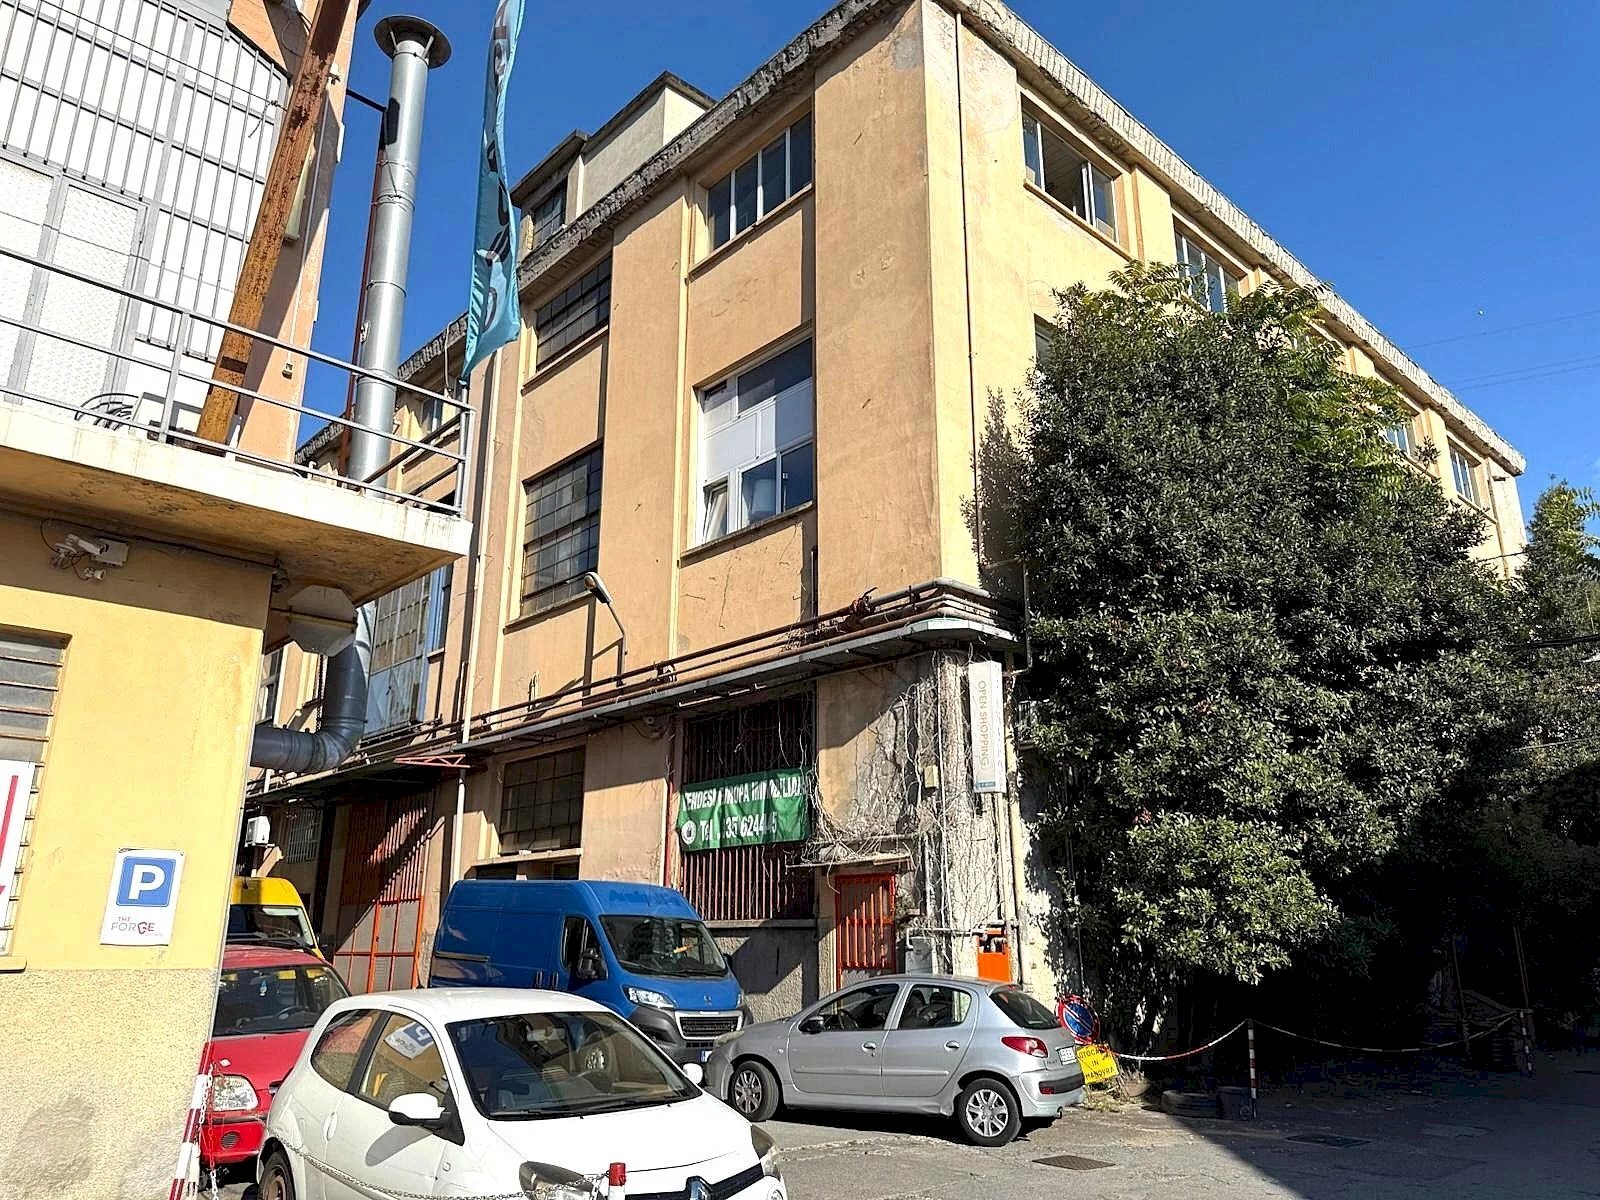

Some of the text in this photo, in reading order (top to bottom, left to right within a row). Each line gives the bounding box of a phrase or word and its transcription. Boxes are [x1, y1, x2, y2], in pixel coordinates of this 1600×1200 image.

[978, 680, 989, 768] OPEN SHOPPING
[128, 864, 165, 900] P
[111, 921, 156, 935] FORGE
